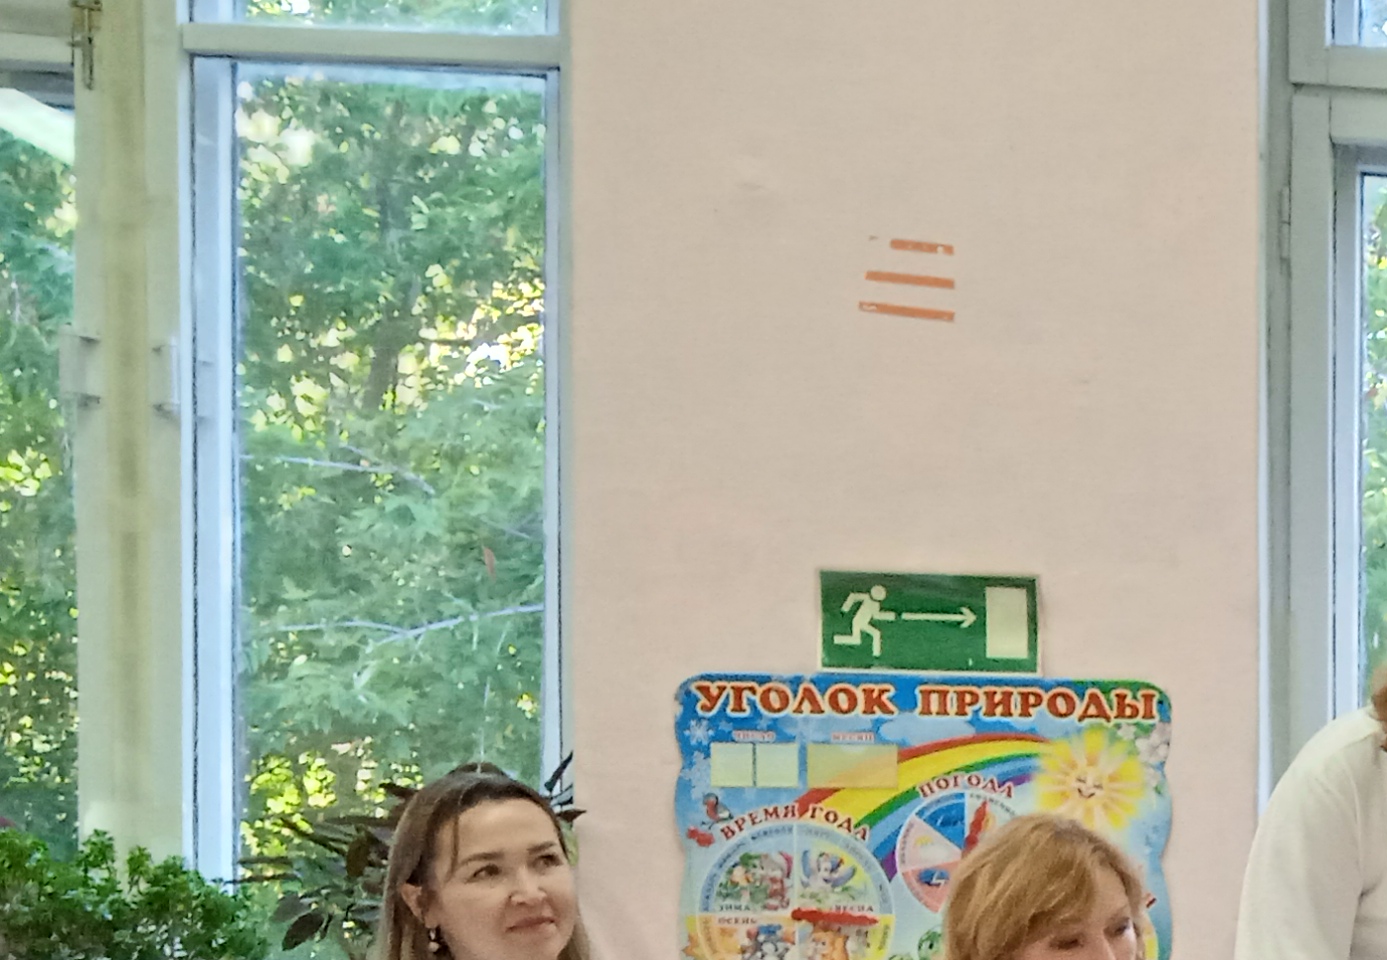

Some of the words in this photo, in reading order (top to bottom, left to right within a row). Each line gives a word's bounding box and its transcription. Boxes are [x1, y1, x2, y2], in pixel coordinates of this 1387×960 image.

[697, 682, 896, 716] УГОЛОК
[917, 687, 1158, 722] ПРИРОДЫ
[918, 774, 1013, 798] ПОГОДА
[719, 805, 799, 841] ВРЕМЯ
[809, 805, 870, 841] ГОДА
